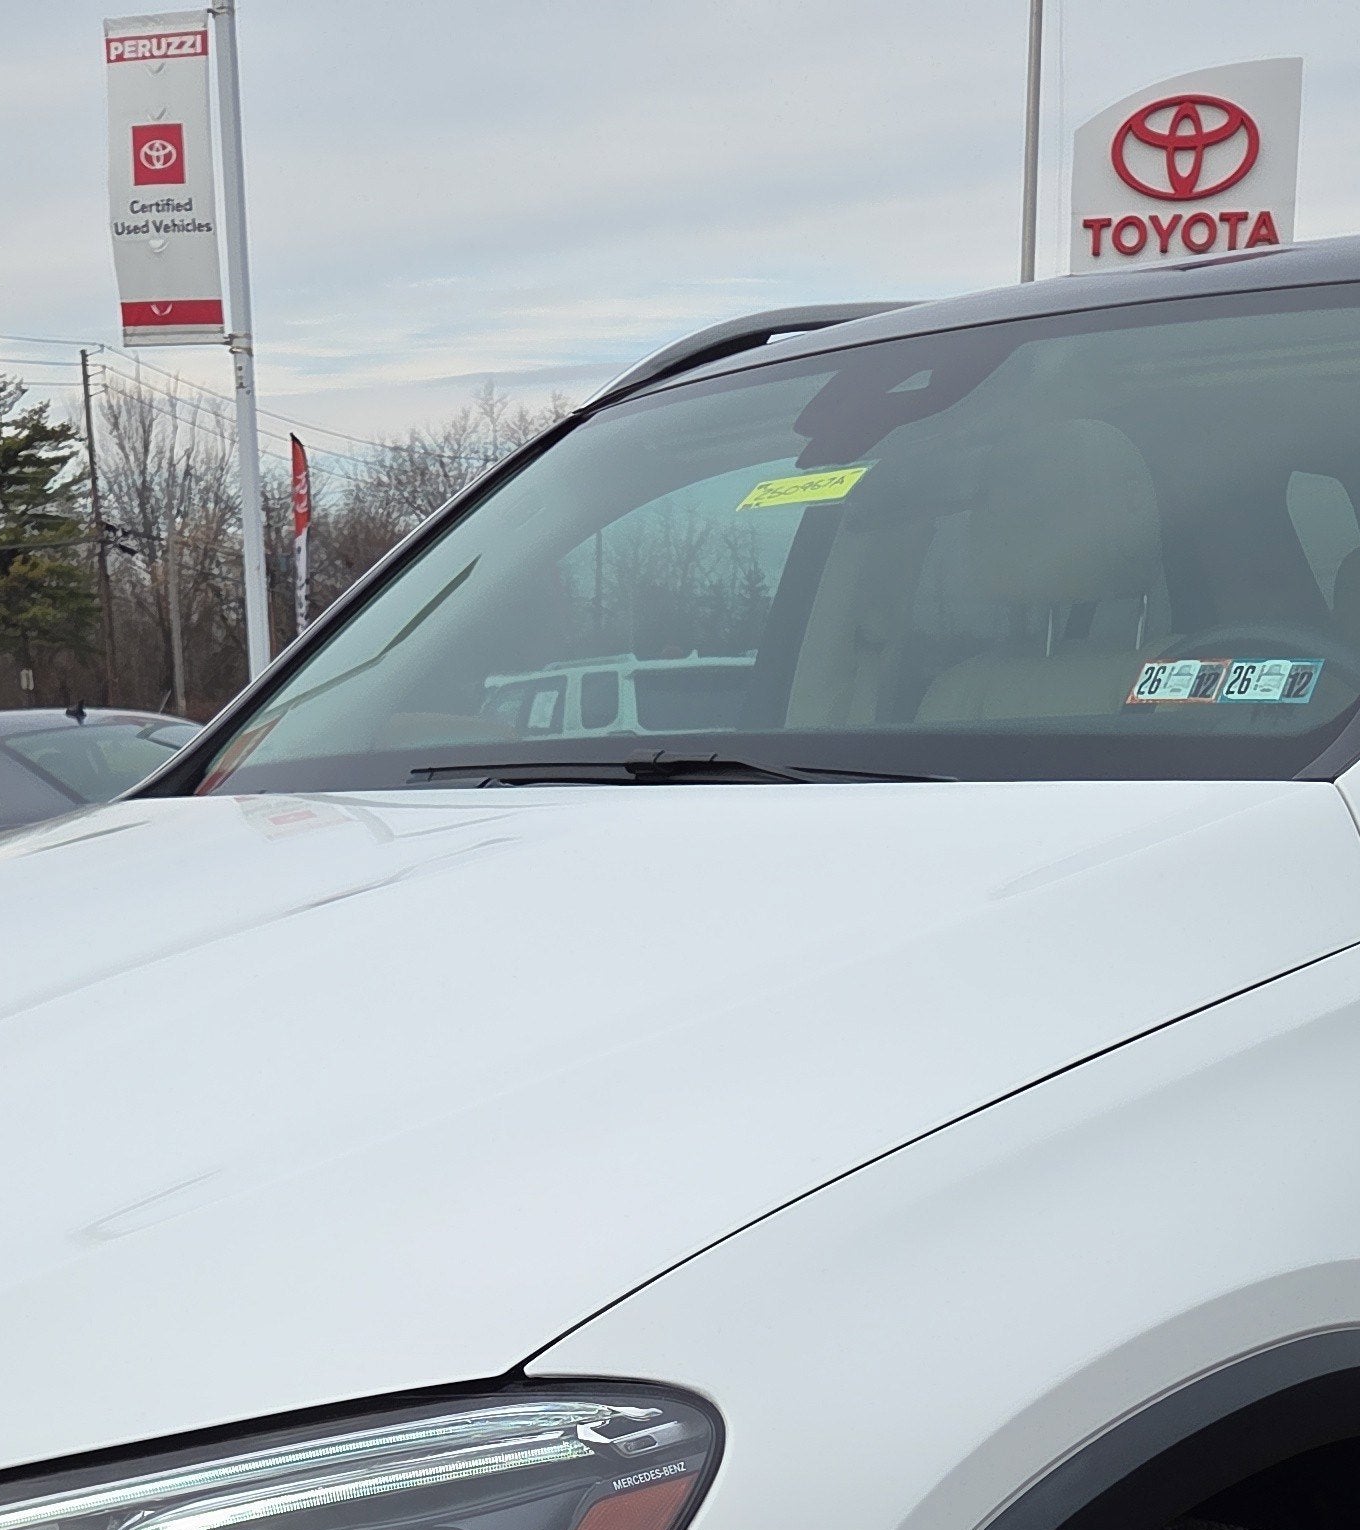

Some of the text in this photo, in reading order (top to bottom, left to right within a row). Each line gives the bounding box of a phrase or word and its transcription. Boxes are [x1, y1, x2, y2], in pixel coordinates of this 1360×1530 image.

[109, 34, 203, 61] PERUZZI
[129, 198, 193, 215] Certified
[113, 217, 213, 236] Used Vehicles
[1082, 210, 1280, 257] TOYOTA
[1137, 665, 1167, 695] 26
[1192, 671, 1221, 698] 12
[1225, 664, 1256, 695] 26
[1284, 670, 1314, 698] 12
[612, 1461, 687, 1491] MERCEDES-BENZ
